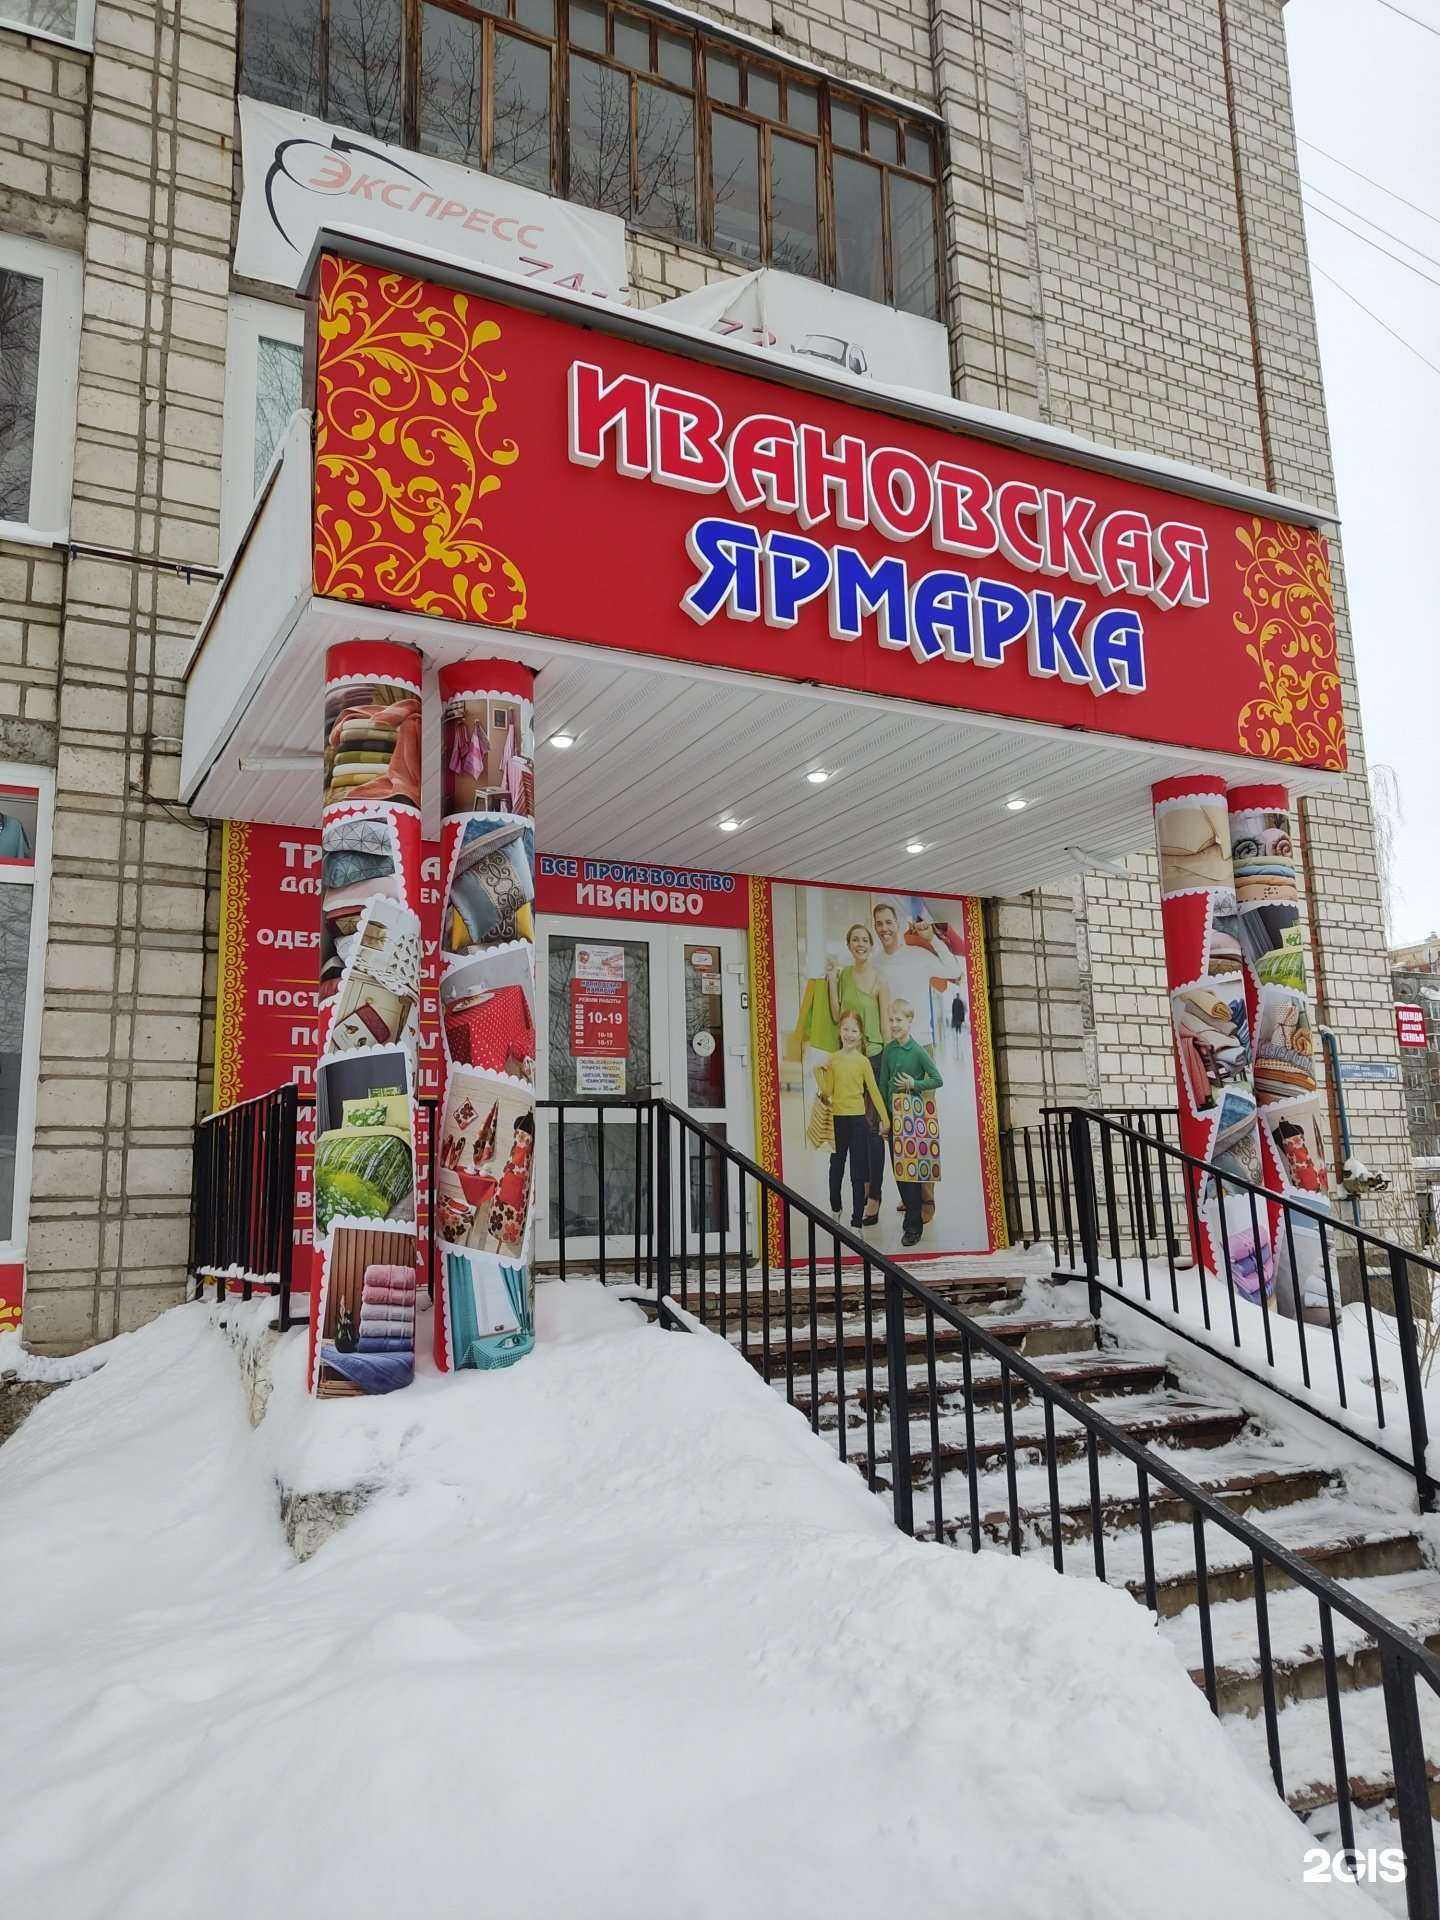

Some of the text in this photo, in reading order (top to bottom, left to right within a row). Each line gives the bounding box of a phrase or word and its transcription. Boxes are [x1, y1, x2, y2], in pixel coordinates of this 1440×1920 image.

[567, 360, 1209, 611] ИВАНОВСКАЯ
[680, 516, 1147, 696] ЯРМАРКА
[540, 857, 736, 894] ВСЕ ПРОИЗВОДСТВО
[576, 882, 704, 915] ИВАНОВО
[587, 1011, 623, 1025] 10-19
[1385, 1066, 1397, 1079] 79
